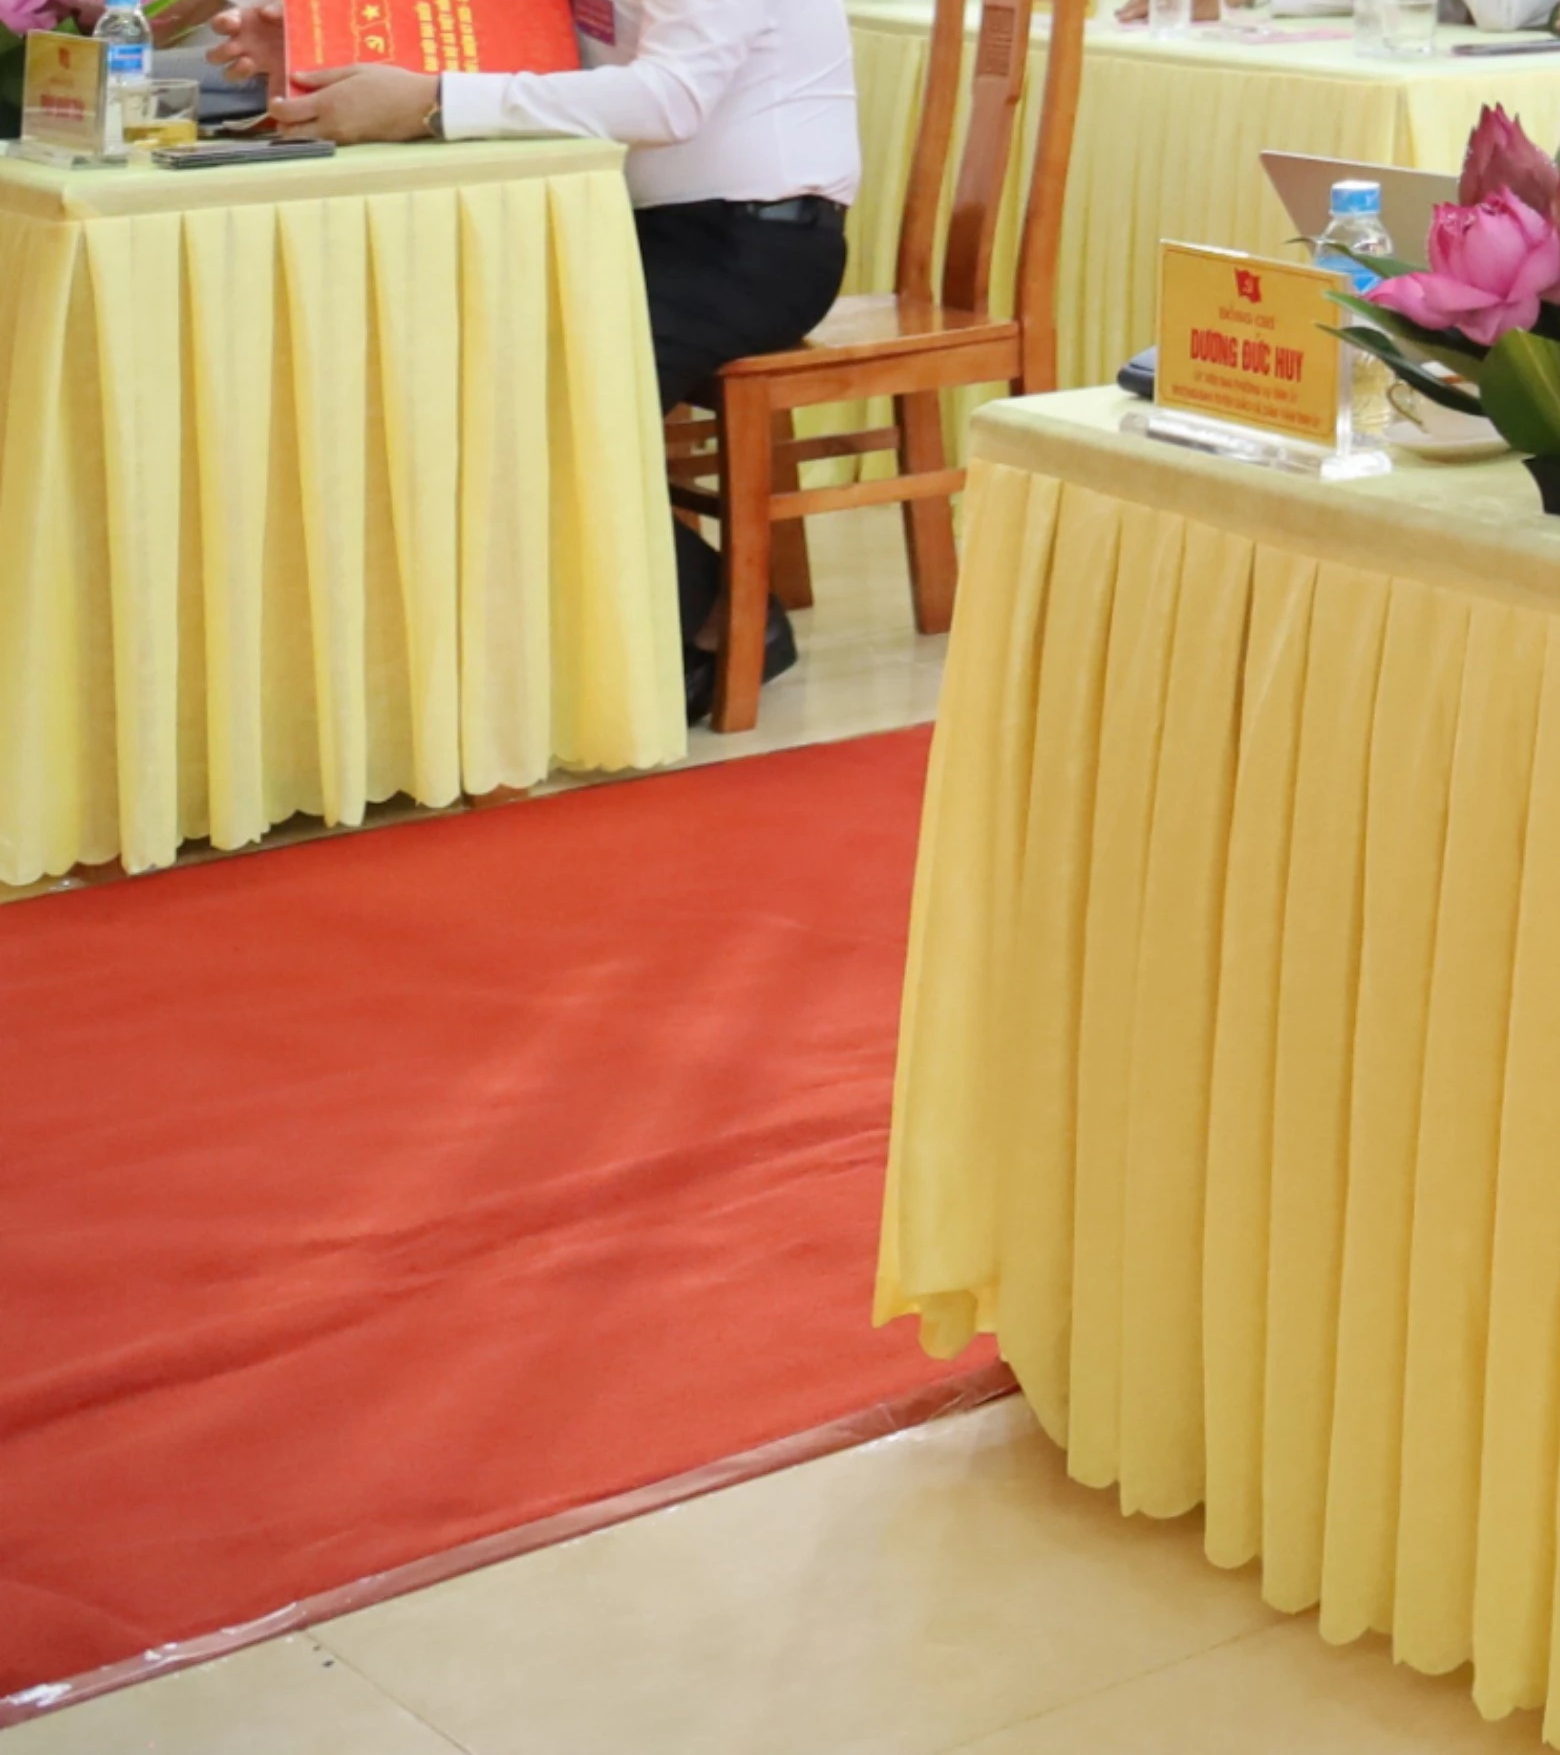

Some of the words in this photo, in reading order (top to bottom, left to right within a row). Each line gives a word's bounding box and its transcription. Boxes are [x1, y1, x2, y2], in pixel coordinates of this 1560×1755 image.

[1189, 328, 1238, 368] DƯƠNG
[1242, 331, 1271, 377] ĐỨC
[1275, 345, 1304, 383] HUY
